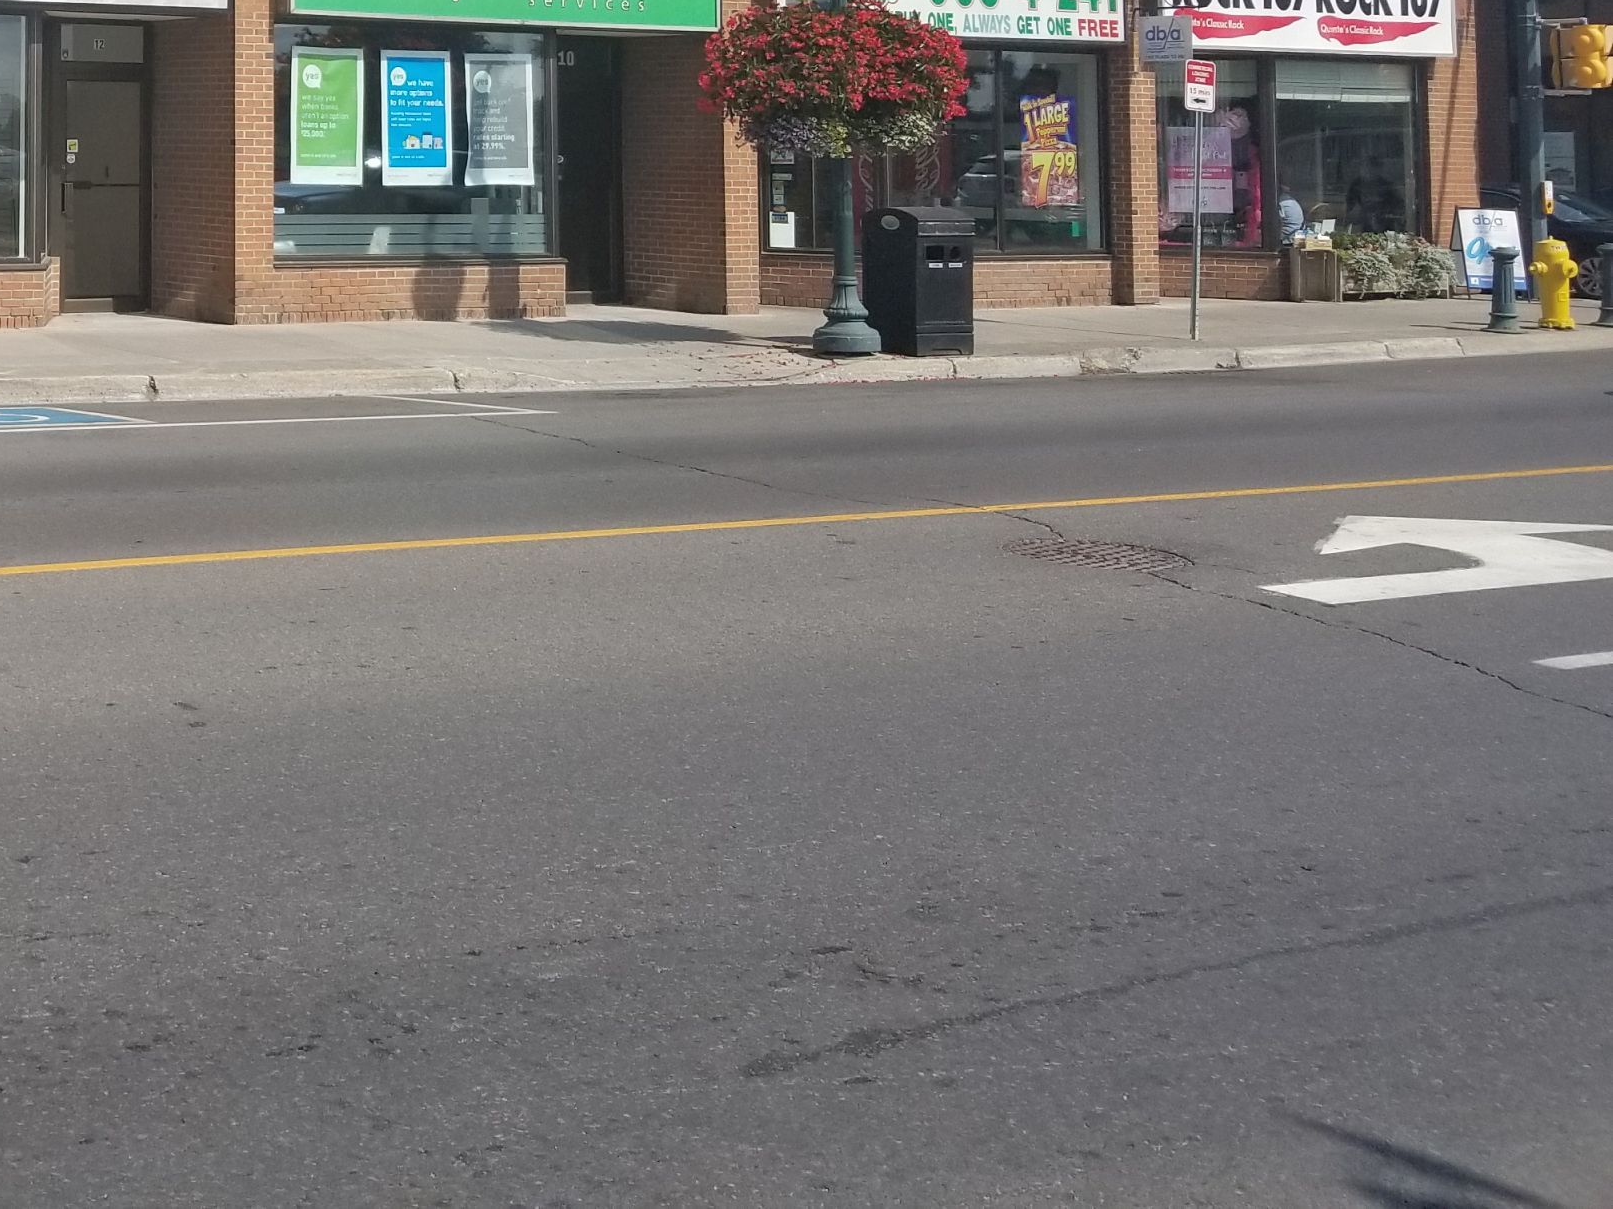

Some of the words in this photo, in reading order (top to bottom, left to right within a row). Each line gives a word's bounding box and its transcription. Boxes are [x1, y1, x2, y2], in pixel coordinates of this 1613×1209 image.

[963, 13, 1011, 35] ALWAYS
[1017, 15, 1040, 35] GET
[1047, 17, 1072, 36] ONE
[1078, 19, 1119, 38] FREE
[94, 39, 105, 50] 12
[557, 50, 575, 66] 10
[476, 78, 489, 87] yes
[1031, 102, 1069, 127] LARGE
